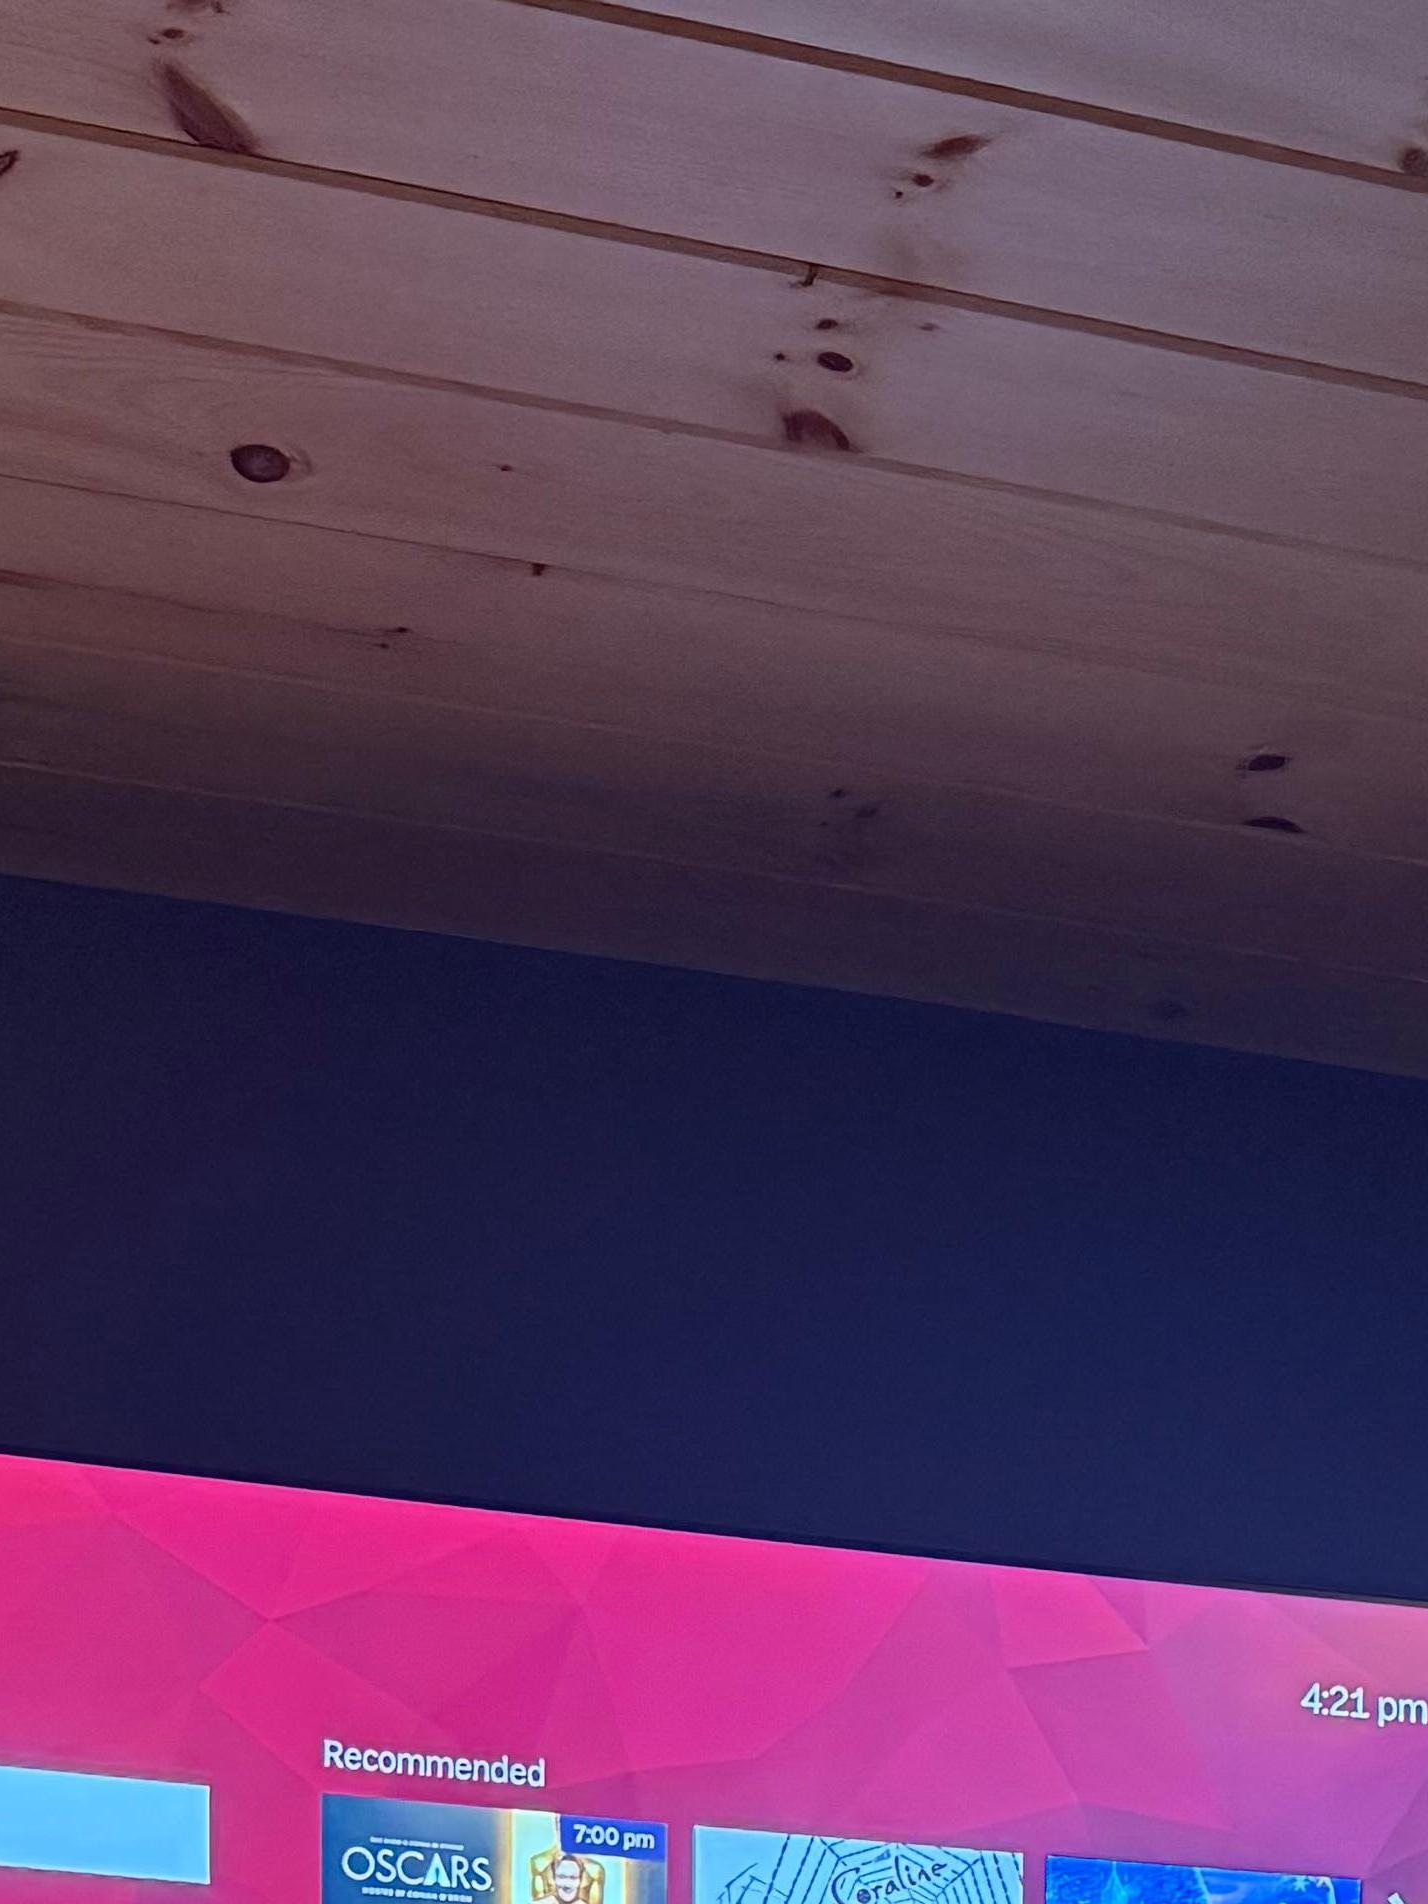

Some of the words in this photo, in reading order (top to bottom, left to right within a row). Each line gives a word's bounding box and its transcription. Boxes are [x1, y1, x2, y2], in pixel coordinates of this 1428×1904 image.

[1300, 1682, 1371, 1720] 4:21
[322, 1739, 546, 1788] Recommended
[573, 1823, 620, 1849] 7:00
[623, 1829, 655, 1852] pm
